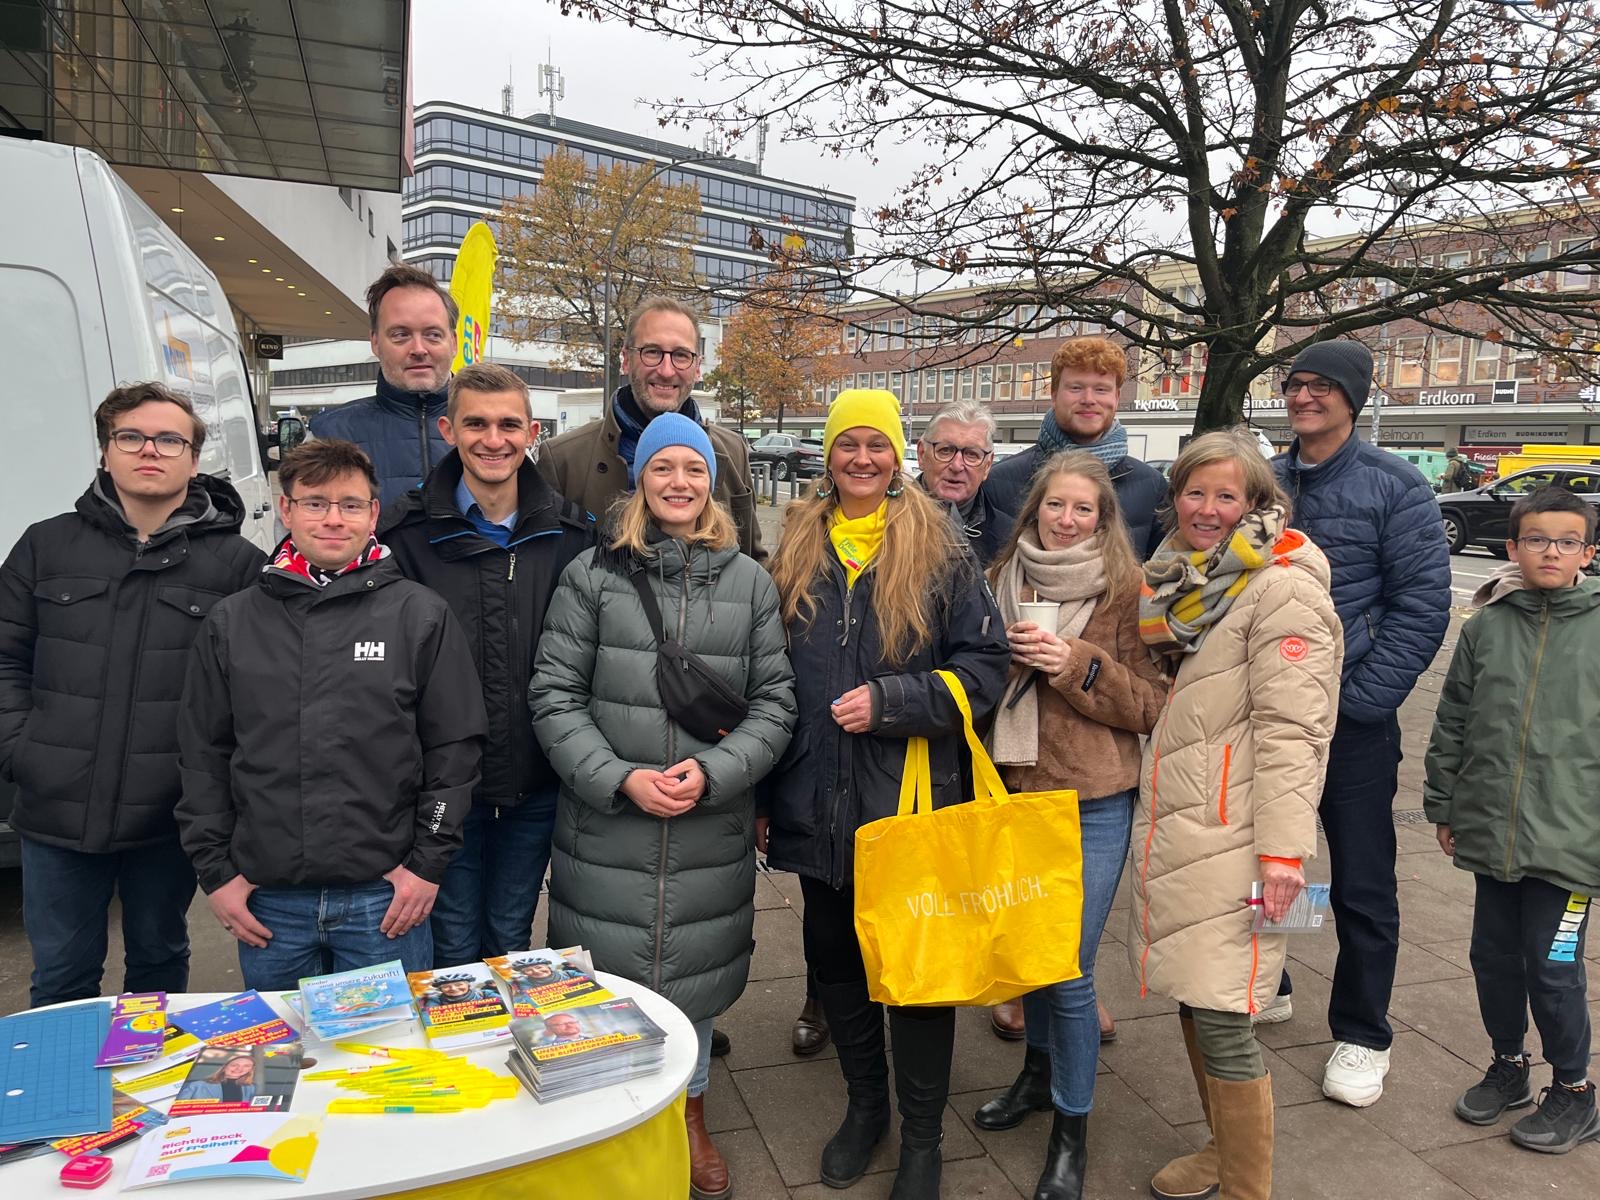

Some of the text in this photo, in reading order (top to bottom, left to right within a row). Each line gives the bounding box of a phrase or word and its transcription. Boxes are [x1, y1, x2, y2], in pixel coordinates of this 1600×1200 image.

[1419, 391, 1475, 405] Erdkorn
[1477, 429, 1507, 438] Erdkorn
[354, 641, 385, 658] HH
[906, 874, 1049, 919] VOLL FRÖHLICH.
[363, 970, 400, 982] Zukunft!
[535, 1045, 568, 1055] UNSERE
[570, 1037, 606, 1049] ERFOLGE
[559, 1035, 639, 1057] BUNDESREGIERUNG
[84, 1125, 139, 1150] BUNDESTAG
[162, 1132, 243, 1149] Richtig Bock
[160, 1139, 247, 1156] auf Freiheit?
